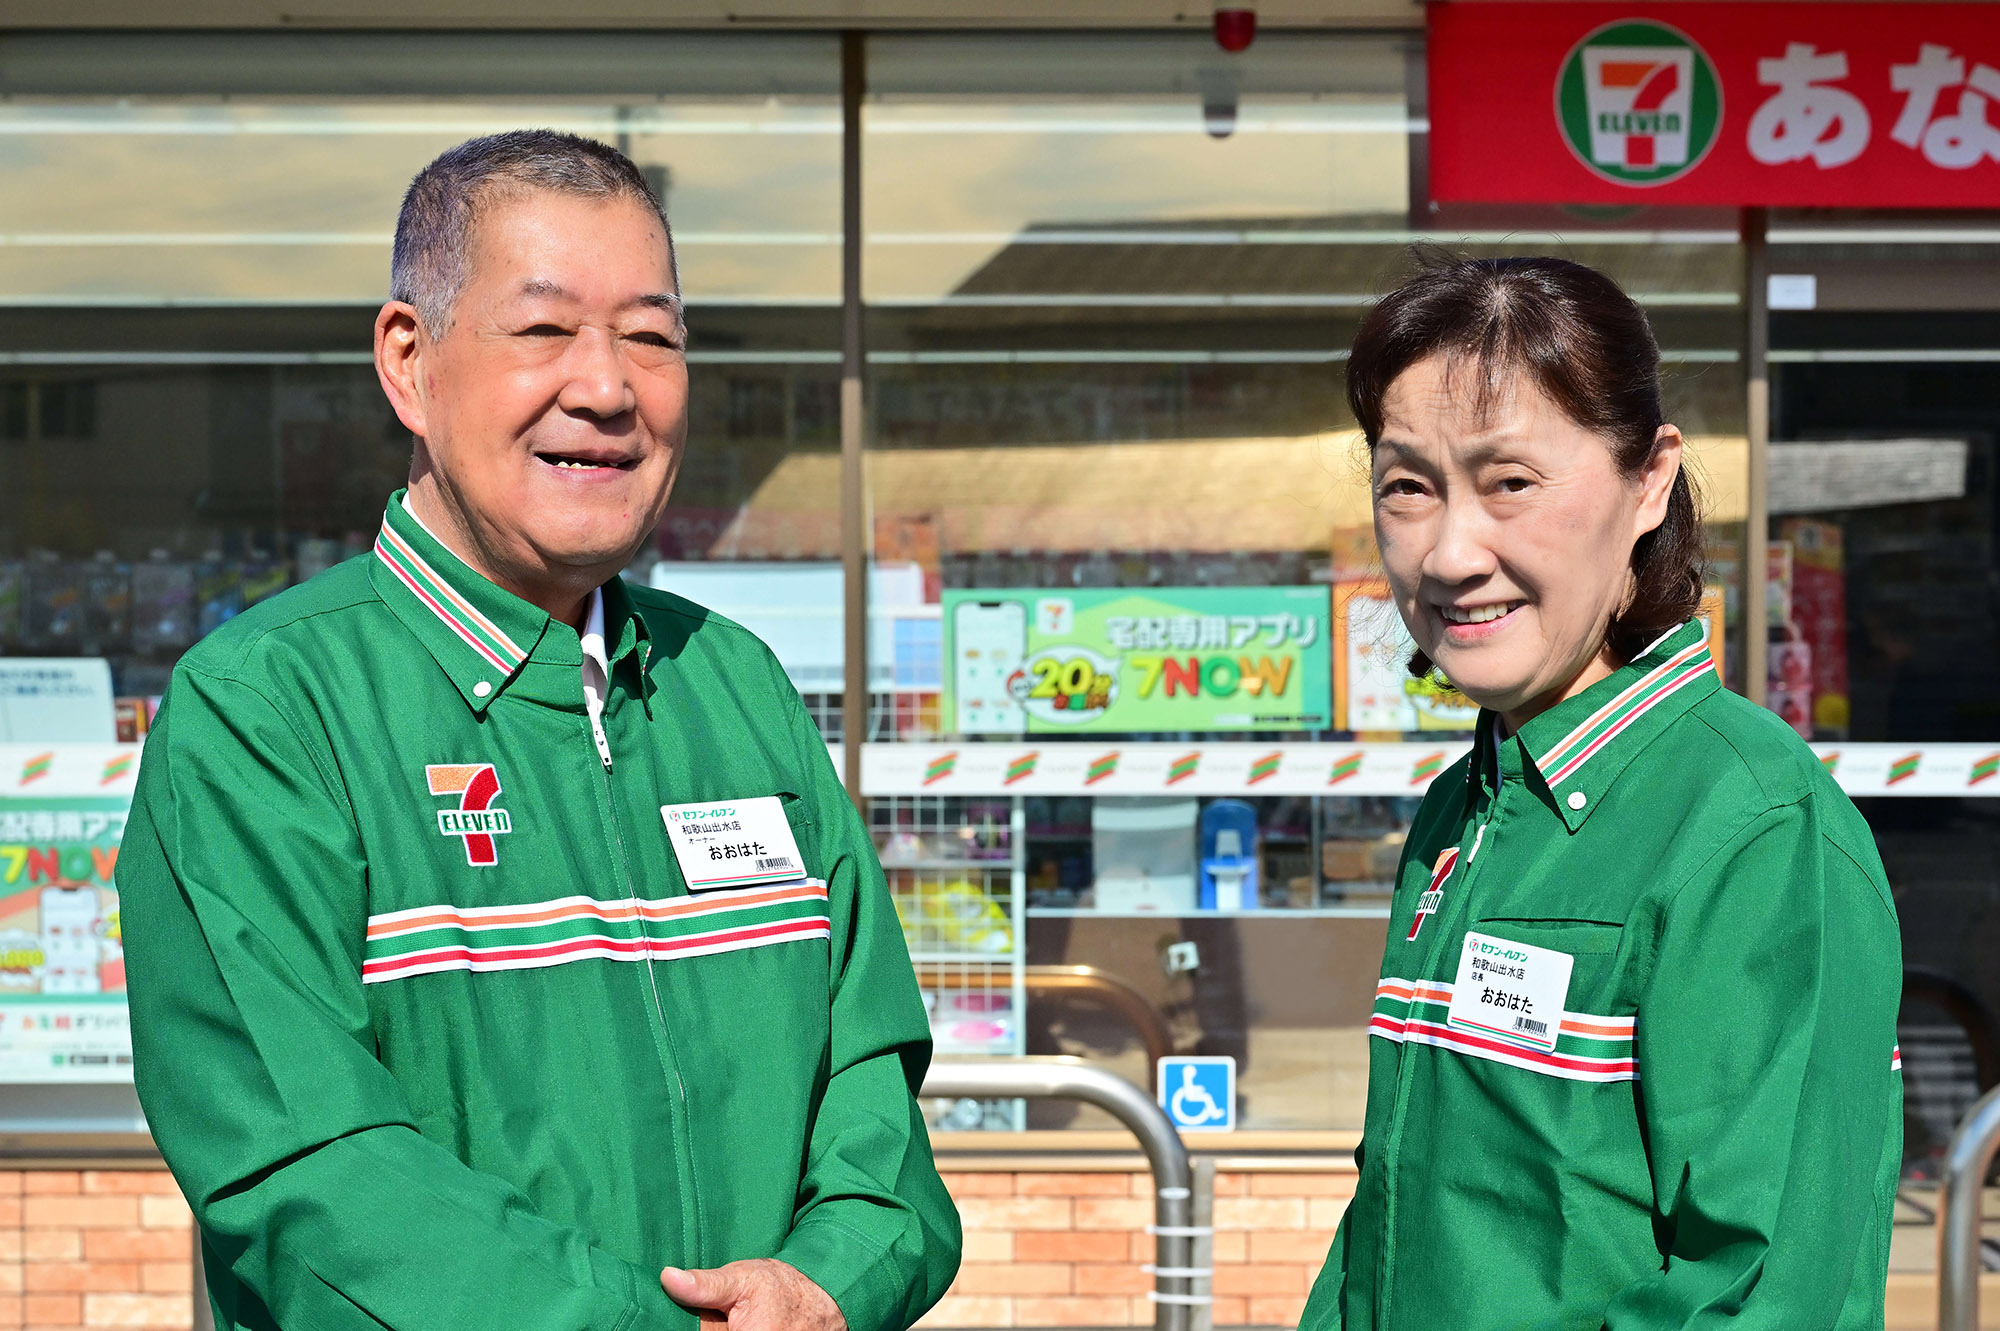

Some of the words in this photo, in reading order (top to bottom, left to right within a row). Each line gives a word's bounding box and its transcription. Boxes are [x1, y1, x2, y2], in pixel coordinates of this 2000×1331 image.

[1131, 656, 1292, 697] 7NOW
[681, 820, 742, 835] 和歌山出水店
[688, 837, 716, 845] オーナー
[708, 841, 768, 861] おおはた
[1471, 956, 1526, 980] 和歌山出水店
[1471, 971, 1484, 982] 店長
[1480, 986, 1533, 1014] おおはた
